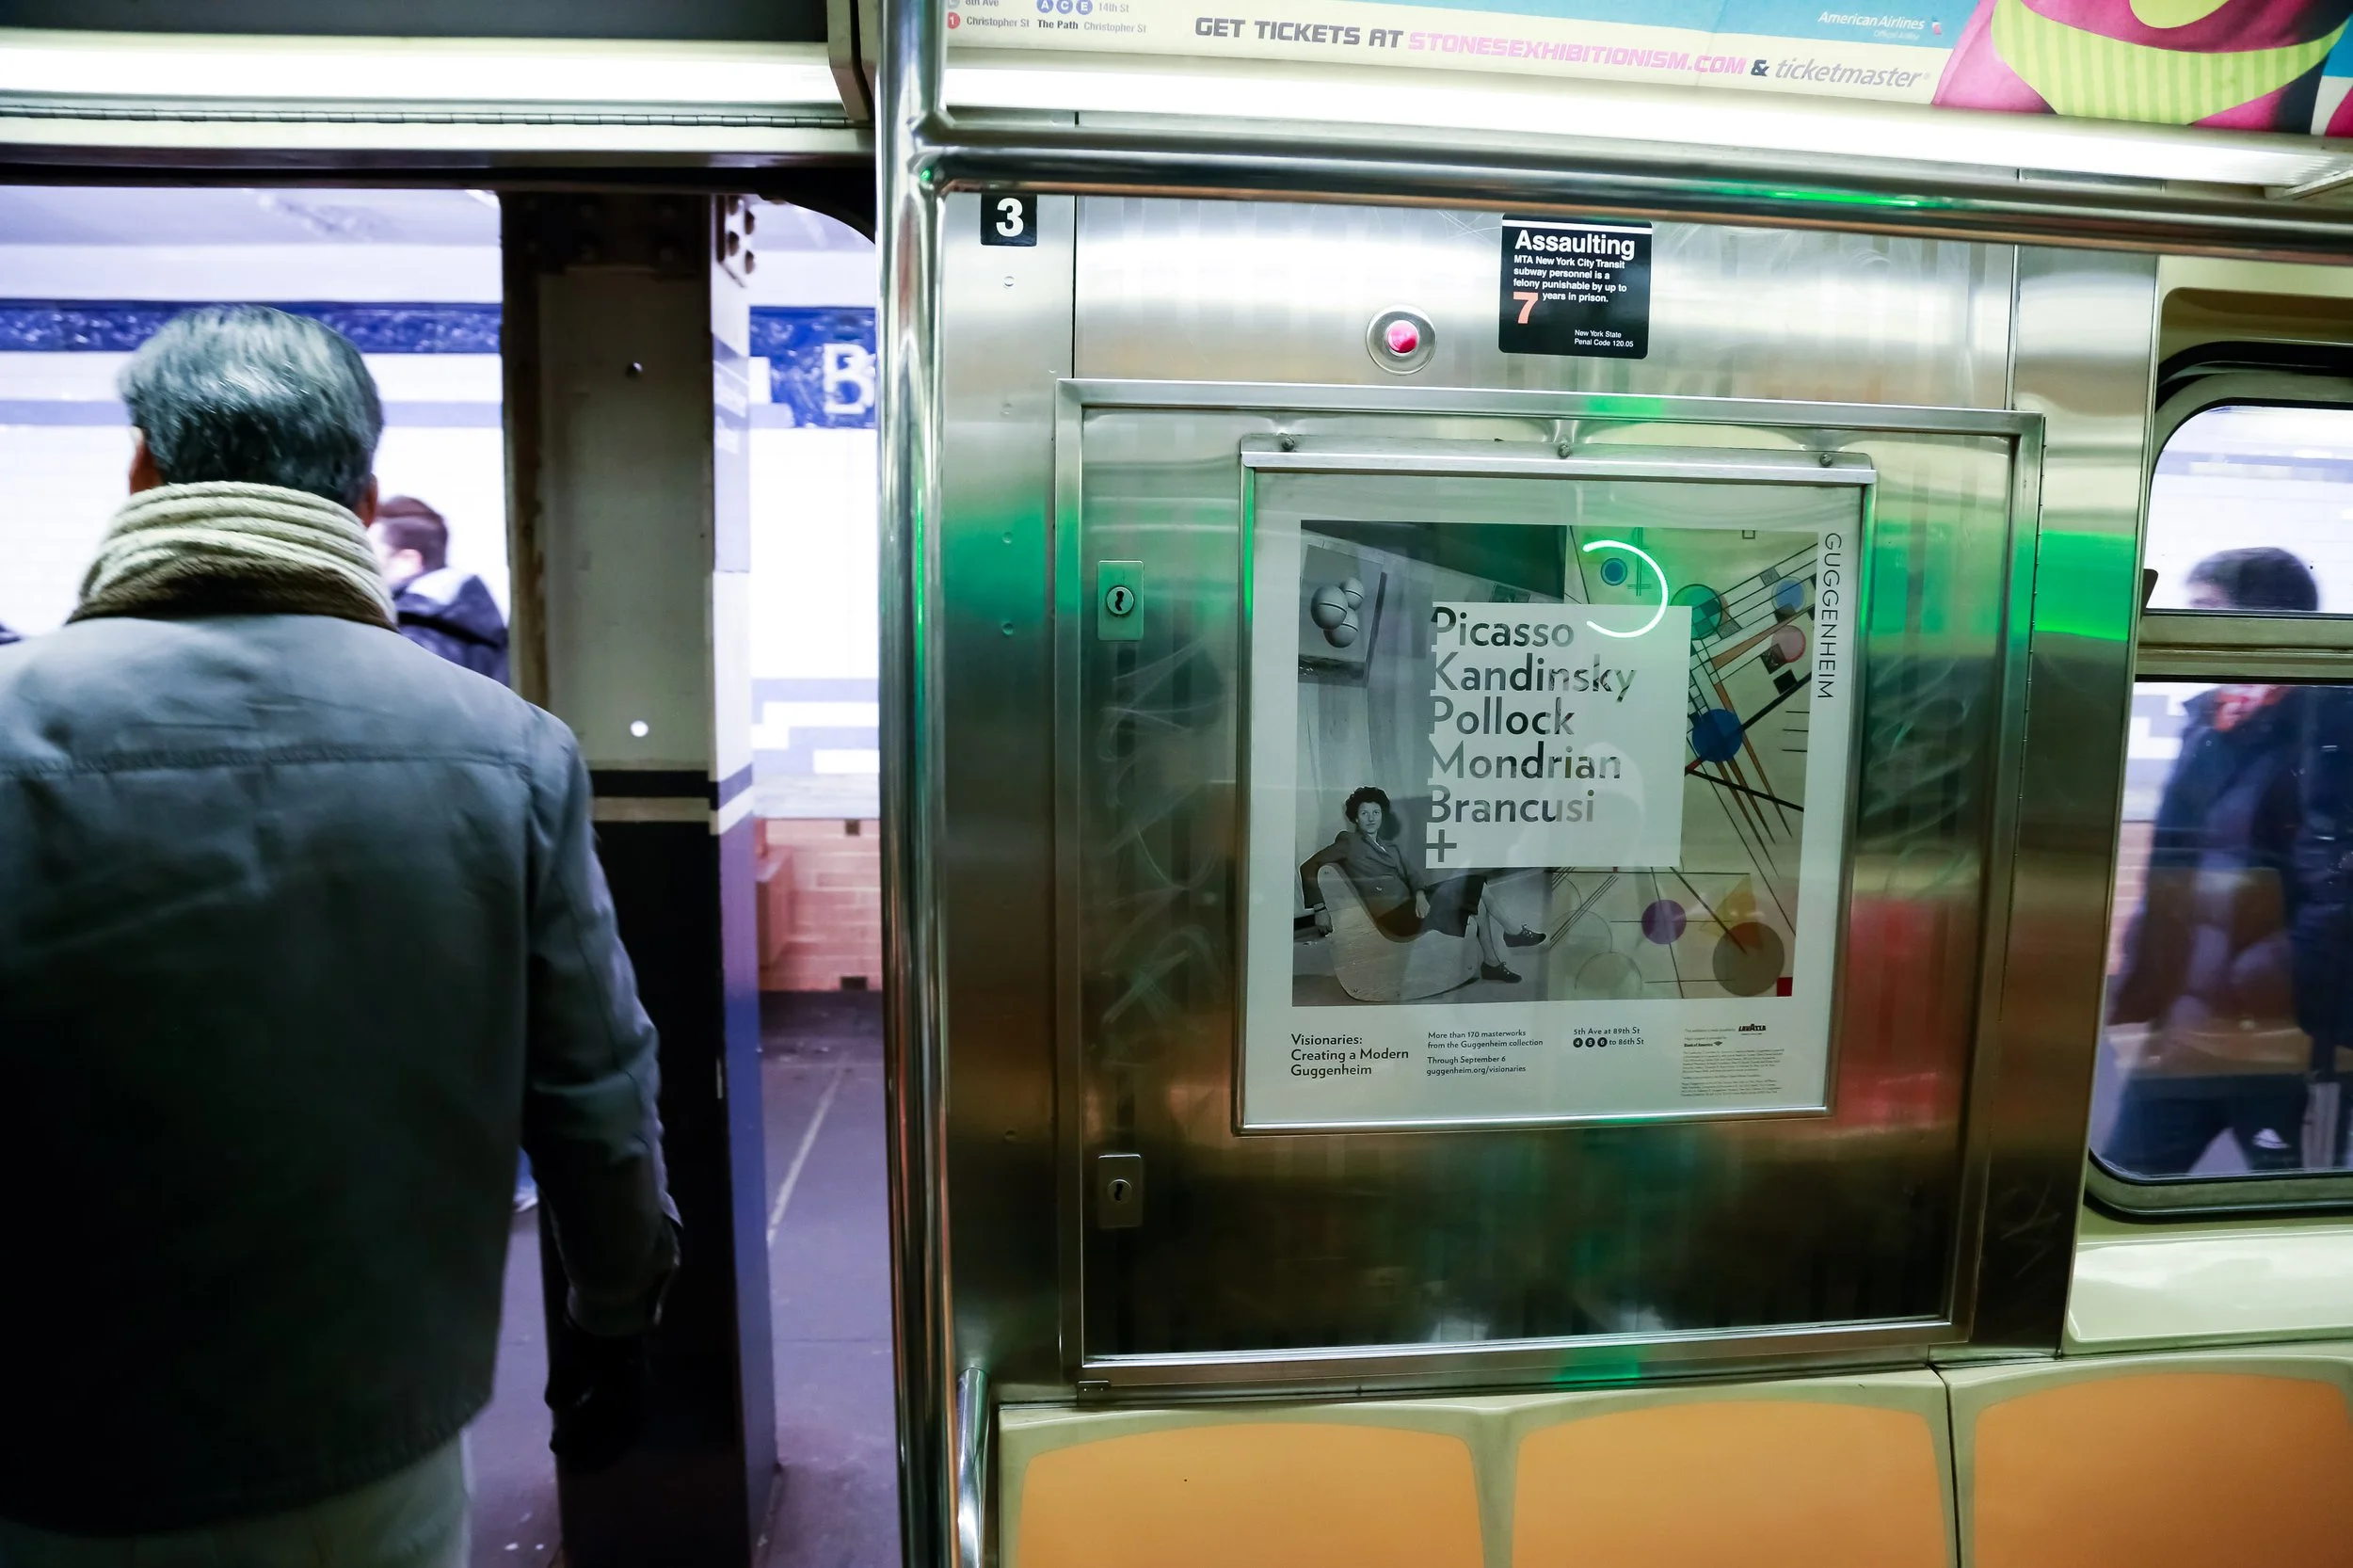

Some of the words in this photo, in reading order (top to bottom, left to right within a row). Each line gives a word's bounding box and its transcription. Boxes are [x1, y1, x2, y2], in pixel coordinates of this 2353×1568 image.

[1098, 3, 1117, 12] 14th
[1120, 4, 1129, 13] St
[967, 16, 1017, 28] Christopher
[1020, 18, 1030, 27] St
[1037, 19, 1054, 29] The
[1057, 20, 1079, 30] Path
[1083, 22, 1135, 34] Christopher
[1137, 24, 1146, 34] St
[1817, 11, 1878, 27] American
[1878, 15, 1926, 30] Airlines
[1195, 17, 1246, 39] GET
[1254, 20, 1361, 46] TICKETS
[1368, 29, 1404, 48] AT
[1408, 31, 1748, 75] STONESEXHIBITIONISM.COM
[1750, 59, 1770, 77] &
[996, 198, 1024, 237] 3
[1514, 229, 1636, 262] Assaulting
[1513, 254, 1534, 264] MTA
[1535, 256, 1555, 266] New
[1556, 257, 1576, 267] York
[1577, 259, 1595, 269] City
[1595, 260, 1625, 270] Transit
[1513, 267, 1547, 279] subway
[1548, 269, 1593, 280] personnel
[1594, 270, 1603, 280] is
[1604, 272, 1610, 280] a
[1513, 279, 1541, 290] felony
[1542, 280, 1591, 292] punishable
[1592, 283, 1603, 293] by
[1604, 285, 1617, 294] up
[1618, 284, 1627, 293] to
[1513, 291, 1539, 325] 7
[1542, 293, 1566, 302] years
[1568, 293, 1577, 301] in
[1578, 294, 1609, 304] prison.
[1590, 329, 1604, 338] York
[1605, 330, 1622, 339] State
[1574, 338, 1593, 346] Penal
[1593, 339, 1611, 347] Code
[1612, 340, 1634, 348] 120.05
[1817, 533, 1842, 698] GUGGENHEIM
[1431, 605, 1575, 647] Picasso
[1431, 650, 1638, 703] Kandinsky
[1429, 696, 1575, 736] Pollock
[1428, 740, 1621, 779] Mondrian
[1426, 784, 1594, 824] Brancusi
[1428, 1031, 1448, 1039] More
[1449, 1031, 1465, 1039] than
[1466, 1030, 1480, 1038] 170
[1481, 1029, 1527, 1038] masterworks
[1573, 1027, 1586, 1035] 5th
[1587, 1027, 1602, 1035] Ave
[1632, 1026, 1641, 1034] St
[1290, 1033, 1363, 1046] Visionaries:
[1427, 1040, 1446, 1049] from
[1460, 1040, 1508, 1050] Guggenheim
[1509, 1038, 1544, 1048] collection
[1618, 1037, 1635, 1046] 86th
[1636, 1036, 1644, 1045] St
[1290, 1049, 1346, 1064] Creating
[1348, 1052, 1356, 1061] a
[1360, 1048, 1410, 1060] Modern
[1427, 1056, 1459, 1065] Through
[1460, 1054, 1499, 1065] September
[1501, 1054, 1506, 1063] 6
[1290, 1064, 1372, 1080] Guggenheim
[1426, 1064, 1527, 1077] guggenheim.org/visionaries
